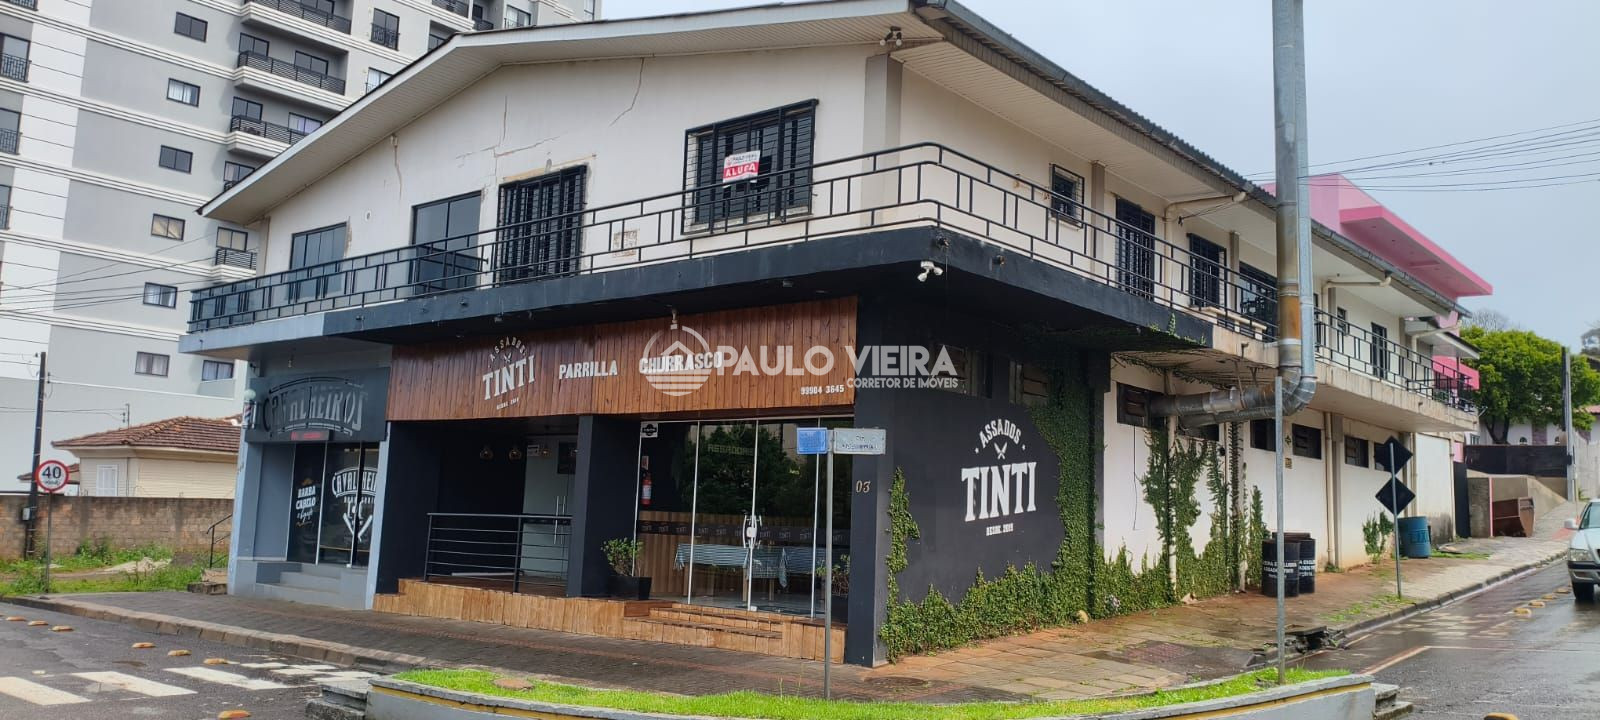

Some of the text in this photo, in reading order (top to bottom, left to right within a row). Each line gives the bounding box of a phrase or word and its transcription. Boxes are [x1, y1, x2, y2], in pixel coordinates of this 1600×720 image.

[559, 360, 618, 380] PARRILLA
[639, 351, 723, 374] CHURRASCO
[482, 354, 535, 400] TINTI
[980, 418, 1021, 449] ASSADOS
[42, 466, 61, 479] 40
[961, 461, 1037, 522] TINTI
